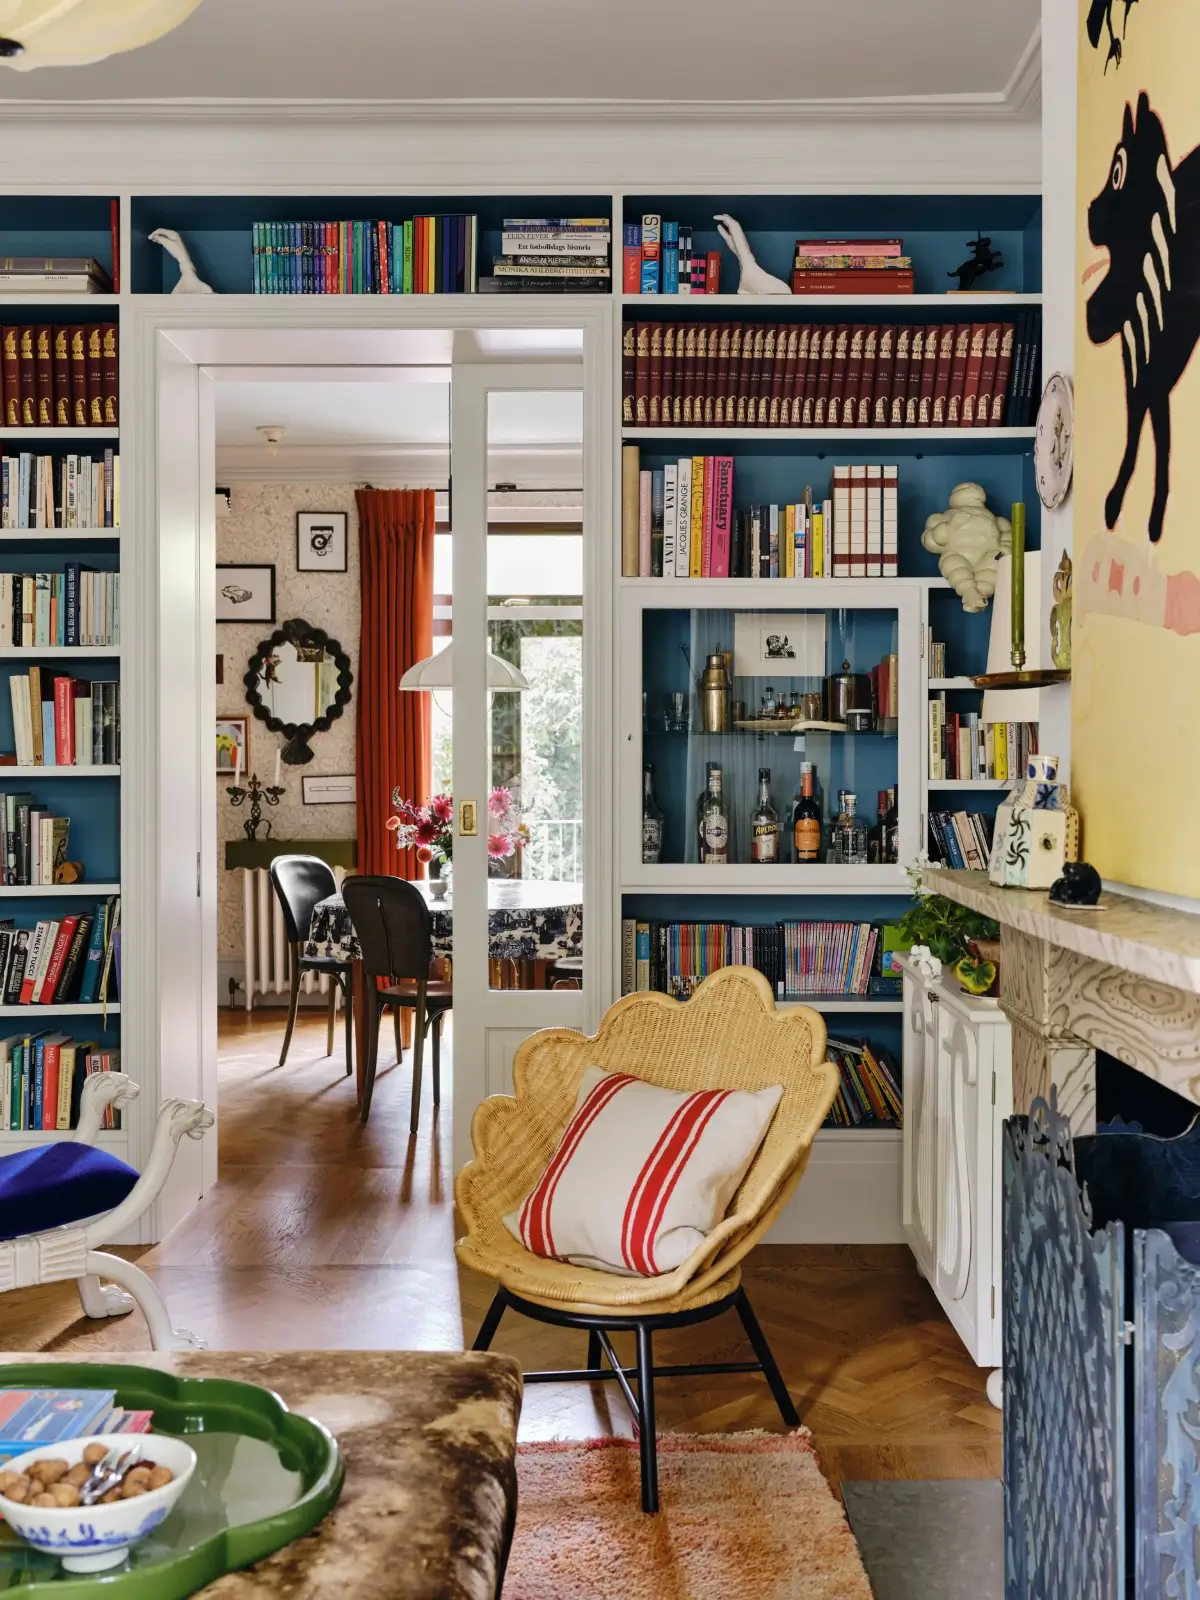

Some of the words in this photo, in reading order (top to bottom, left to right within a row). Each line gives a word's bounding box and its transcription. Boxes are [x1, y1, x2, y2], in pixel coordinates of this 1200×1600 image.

[529, 243, 566, 251] fotbollslags
[692, 460, 704, 481] May
[665, 481, 675, 509] LUNA
[680, 484, 688, 518] GRANGE
[716, 460, 731, 531] Sanctuary
[665, 535, 674, 564] LUNA
[679, 520, 687, 556] JACQUES
[33, 926, 44, 955] STANLEY
[77, 919, 88, 934] IAN
[52, 933, 66, 961] WENGER
[68, 934, 84, 962] WRIGHT
[16, 954, 25, 971] TOTAL
[28, 956, 37, 977] TUCCI
[13, 972, 22, 993] RECALL
